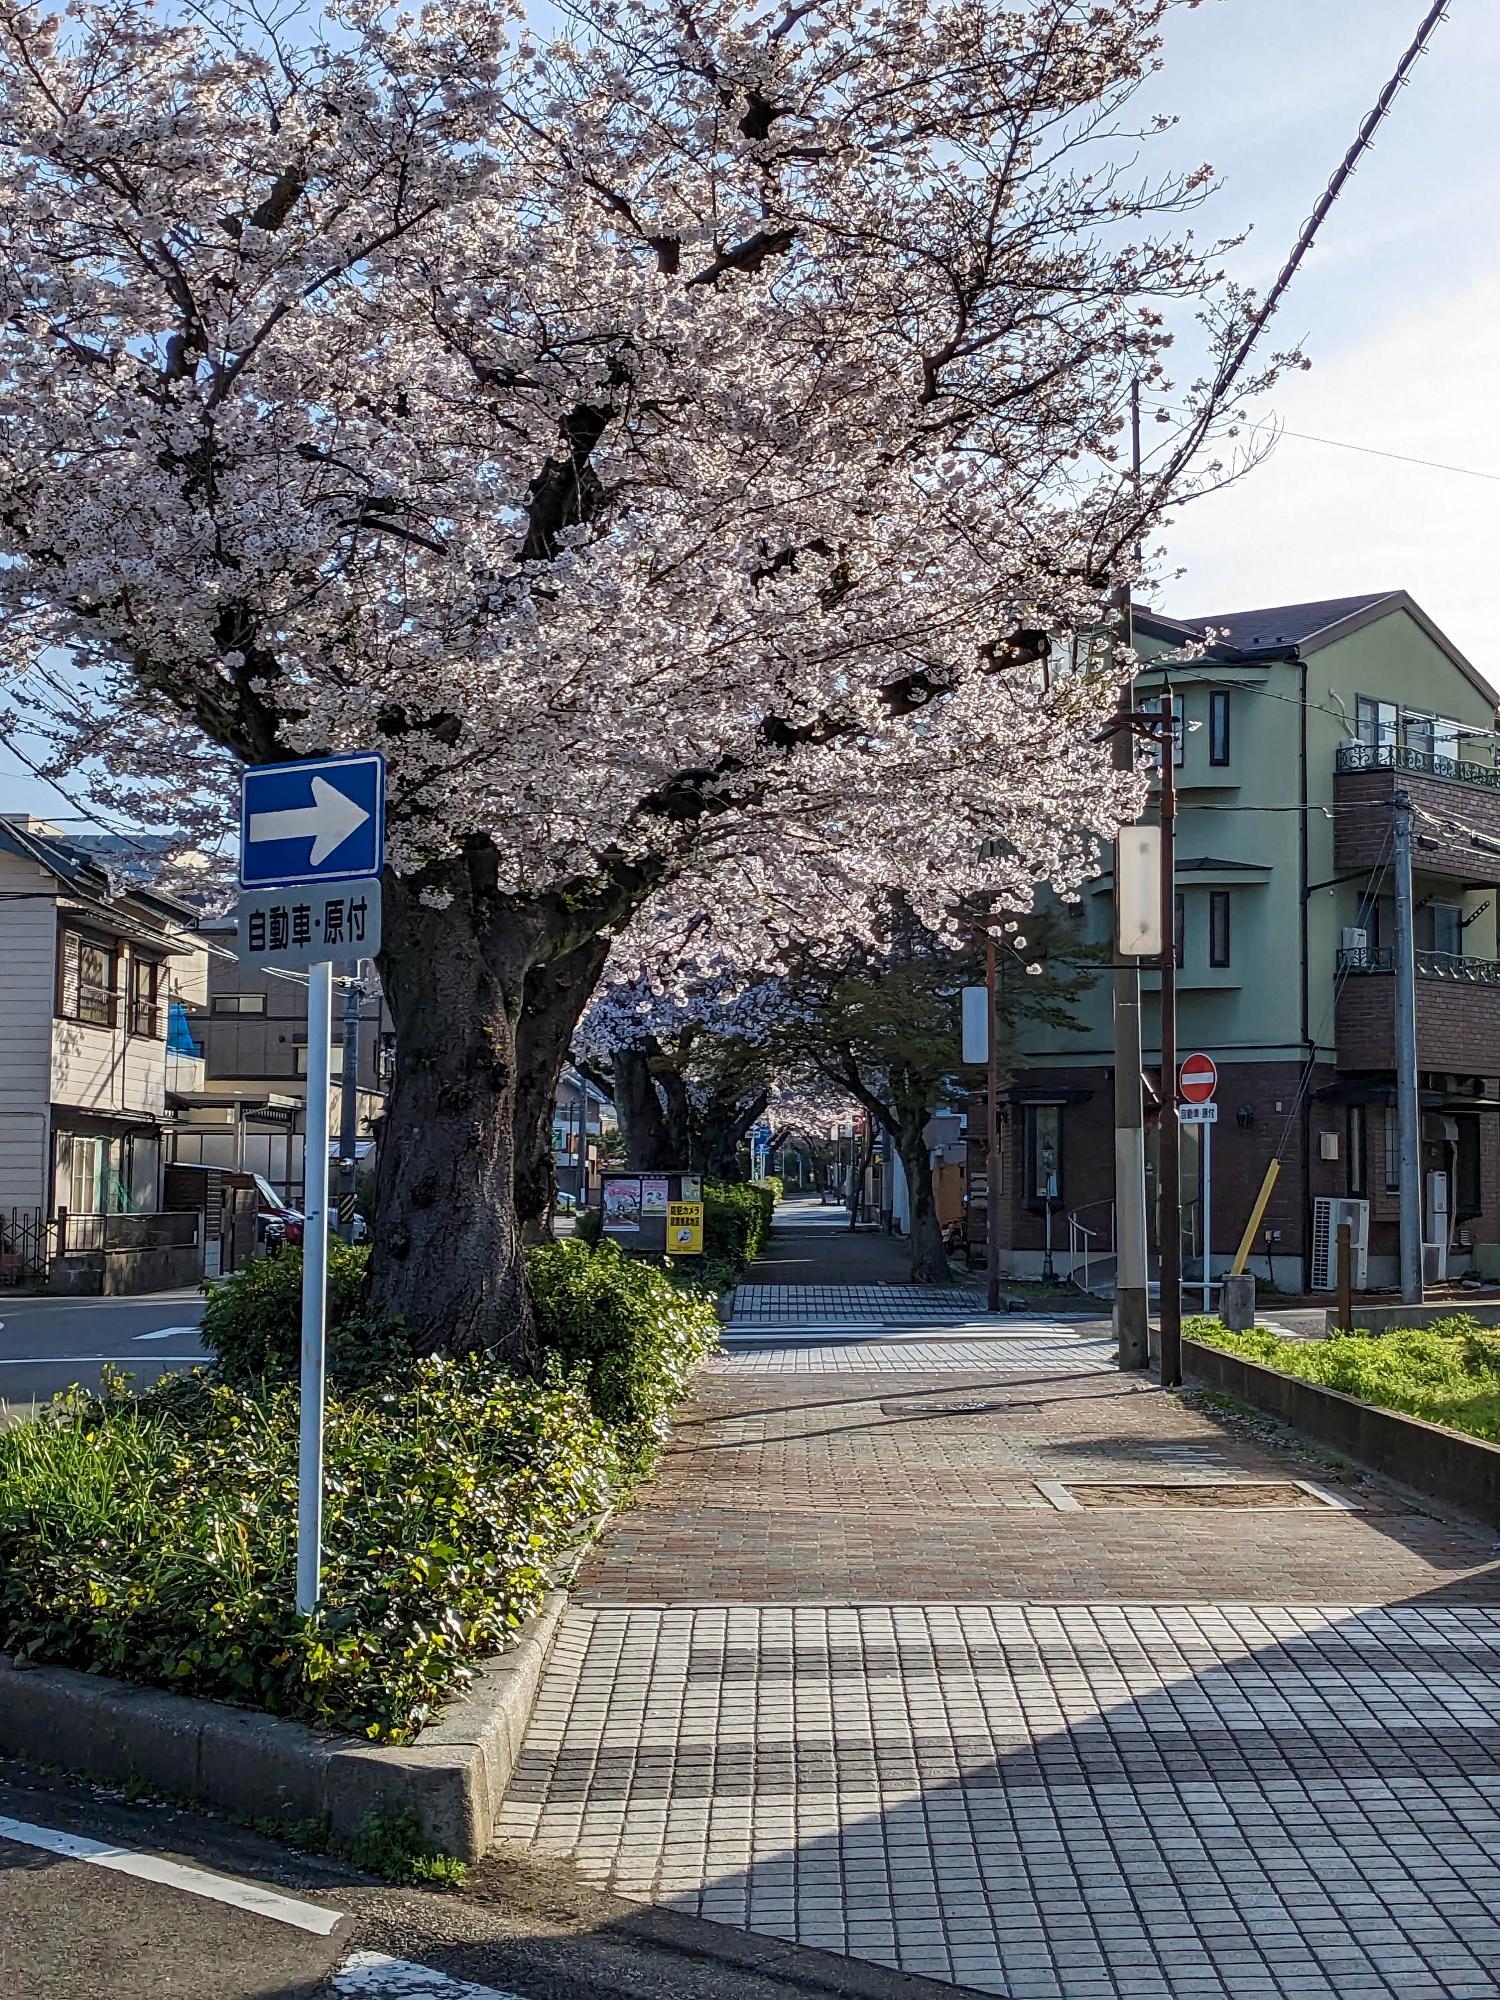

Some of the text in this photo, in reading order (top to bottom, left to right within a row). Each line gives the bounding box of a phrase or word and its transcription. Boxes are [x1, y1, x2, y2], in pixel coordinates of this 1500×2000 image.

[249, 896, 368, 952] 自動車・原付
